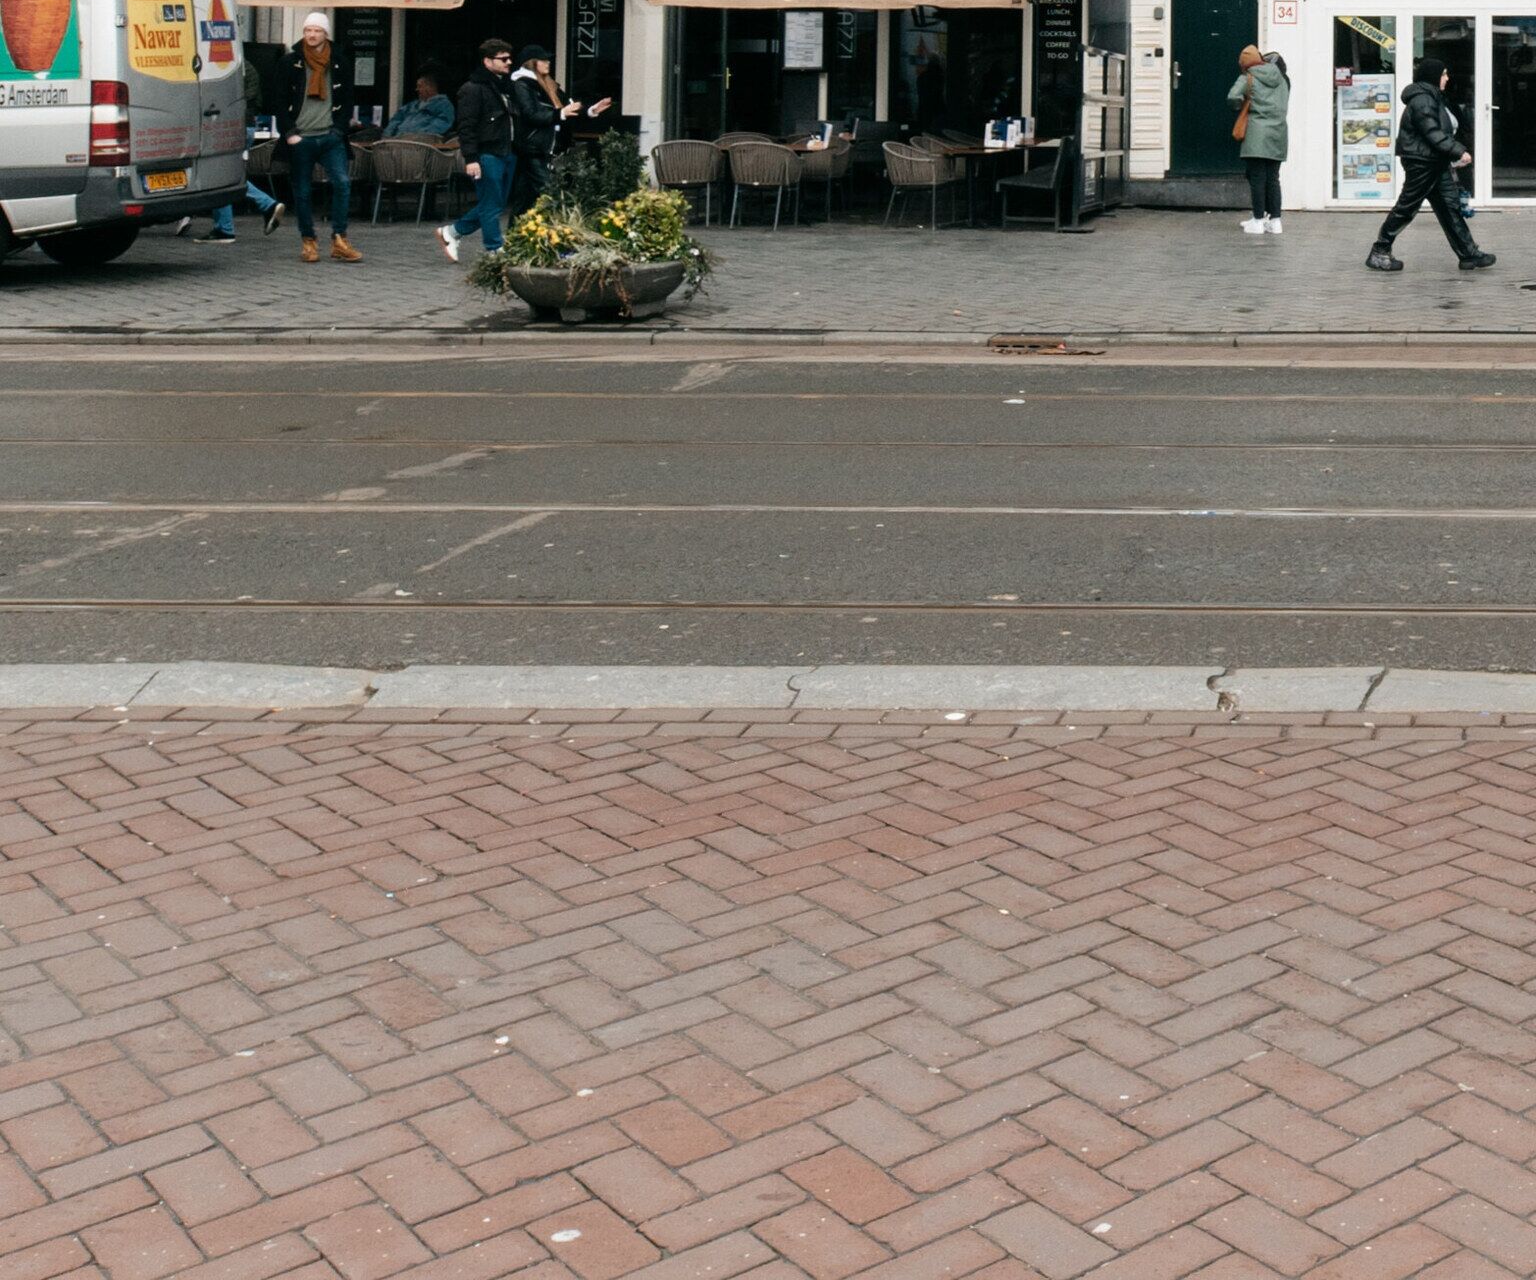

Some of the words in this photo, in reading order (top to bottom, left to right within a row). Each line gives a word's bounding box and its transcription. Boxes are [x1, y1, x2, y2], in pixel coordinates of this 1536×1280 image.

[1278, 6, 1292, 18] 34
[134, 24, 182, 49] Nawar
[1350, 18, 1388, 45] DISCOUNT
[8, 84, 69, 105] Amsterdam
